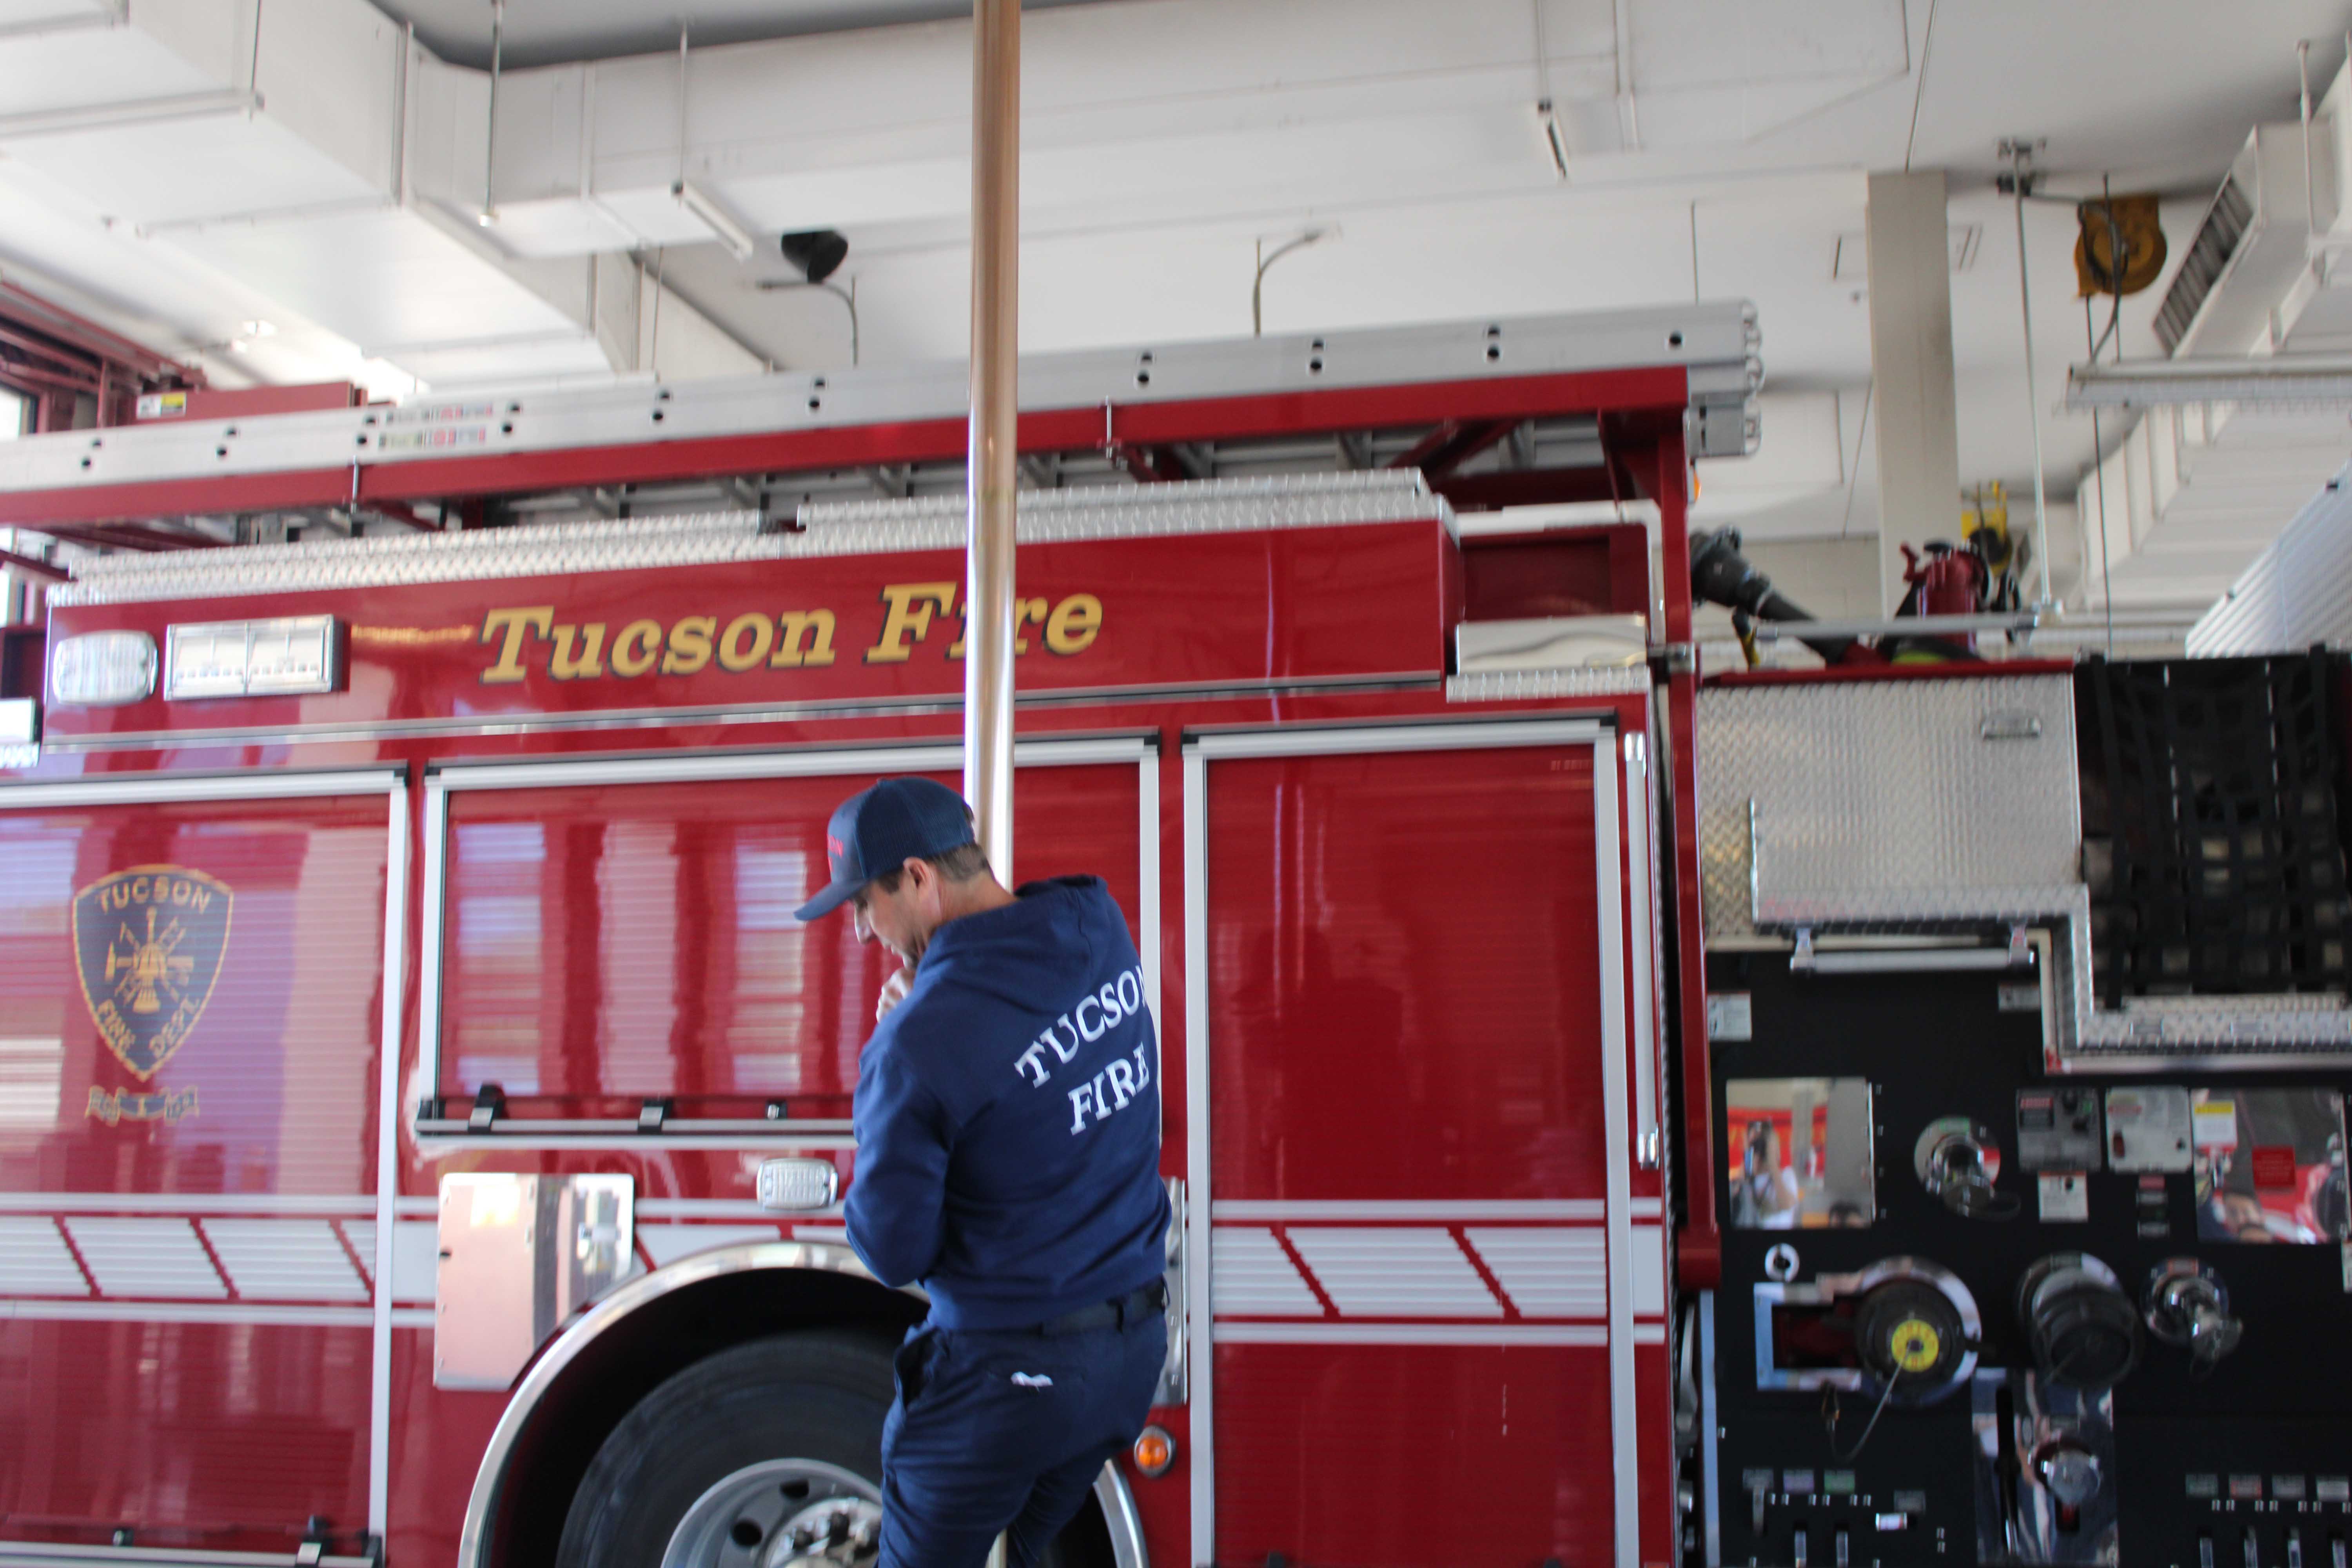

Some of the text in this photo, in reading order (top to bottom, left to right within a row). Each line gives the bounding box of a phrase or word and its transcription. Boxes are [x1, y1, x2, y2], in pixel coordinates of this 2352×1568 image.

[479, 606, 836, 684] Tucson
[95, 877, 212, 915] TUCSON
[1067, 1041, 1150, 1136] FIRE
